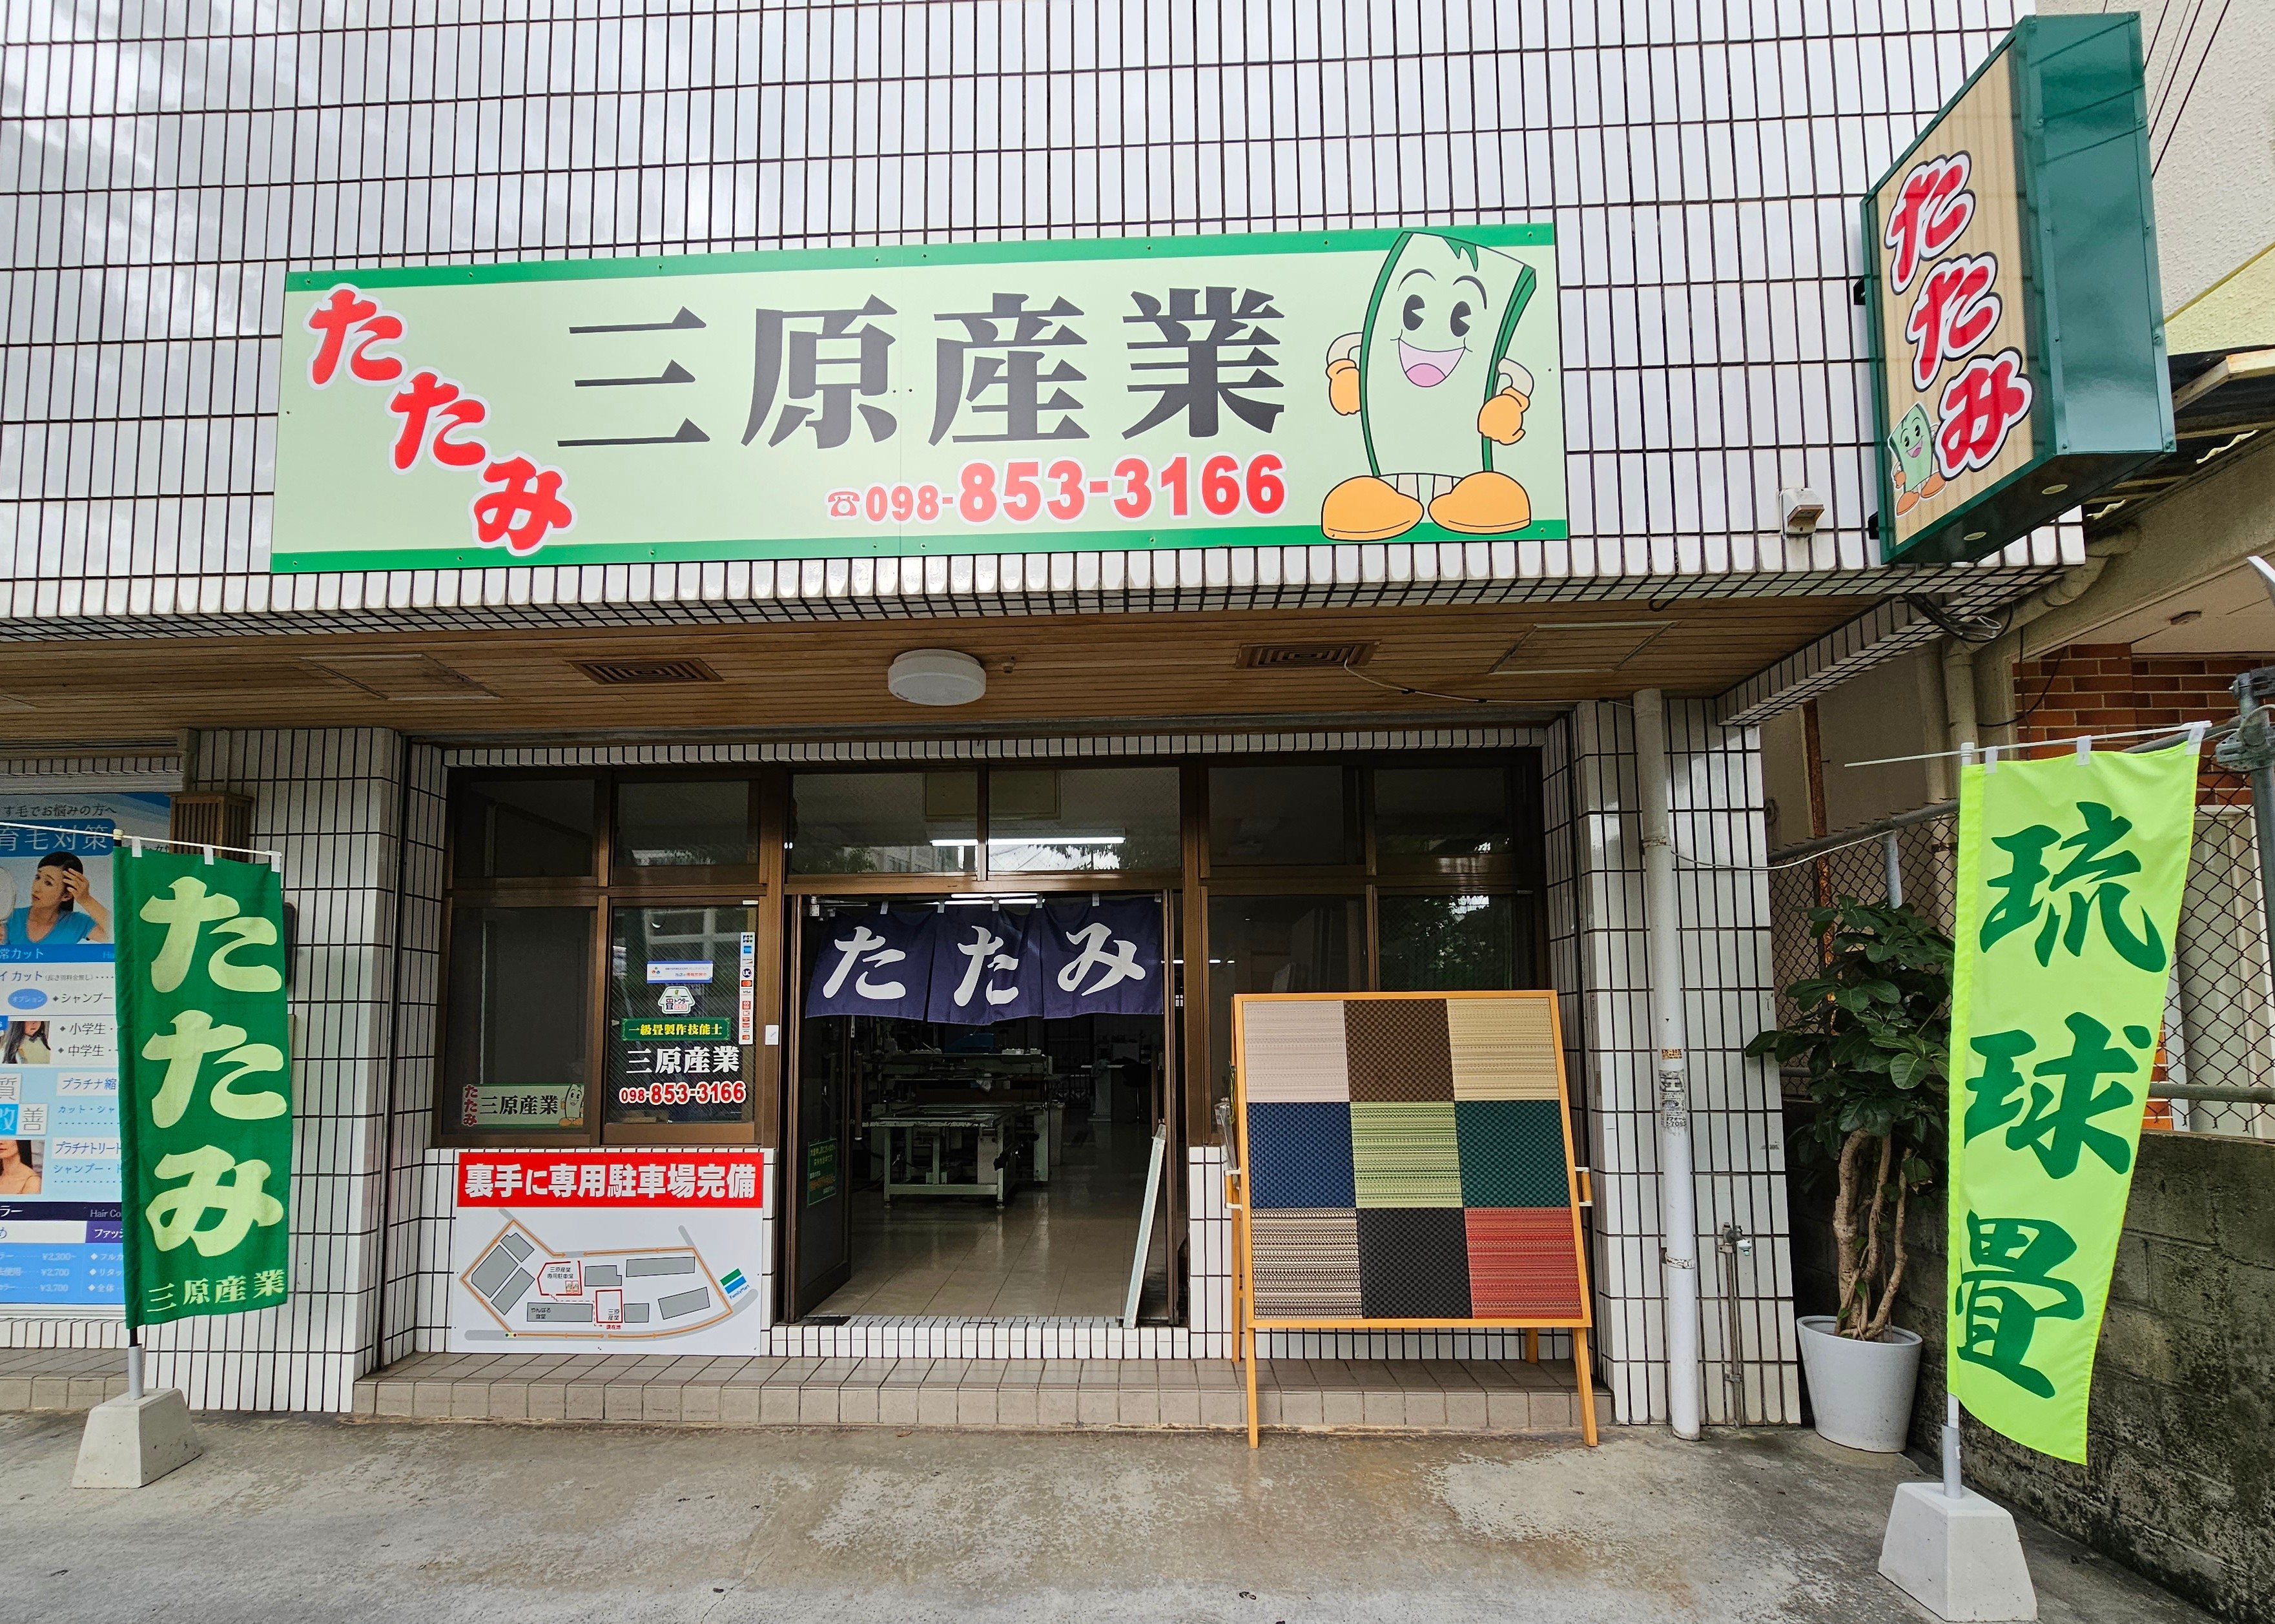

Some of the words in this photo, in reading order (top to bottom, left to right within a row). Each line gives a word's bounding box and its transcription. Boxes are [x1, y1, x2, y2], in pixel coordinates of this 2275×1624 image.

[1888, 155, 2030, 476] たたみ
[557, 285, 1286, 449] 三原産業
[307, 288, 573, 551] たたみ
[865, 453, 1285, 522] 098-853-3166
[0, 824, 109, 851] 育毛対策
[12, 971, 43, 982] カット
[823, 922, 1146, 1007] たたみ
[61, 992, 113, 1003] シャンプー
[69, 1022, 106, 1035] 小学生
[68, 1044, 104, 1057] 中学生
[139, 876, 288, 1258] たたみ
[626, 1045, 740, 1074] 三原産業
[463, 1085, 479, 1126] たたみ
[480, 1095, 559, 1115] 三原産業
[620, 1081, 746, 1104] 098-853-3166
[1955, 801, 2167, 1399] 琉球畳
[464, 1163, 756, 1198] 裏手に専用駐車場完備
[90, 1209, 108, 1218] Hair
[146, 1268, 286, 1313] 三原産業
